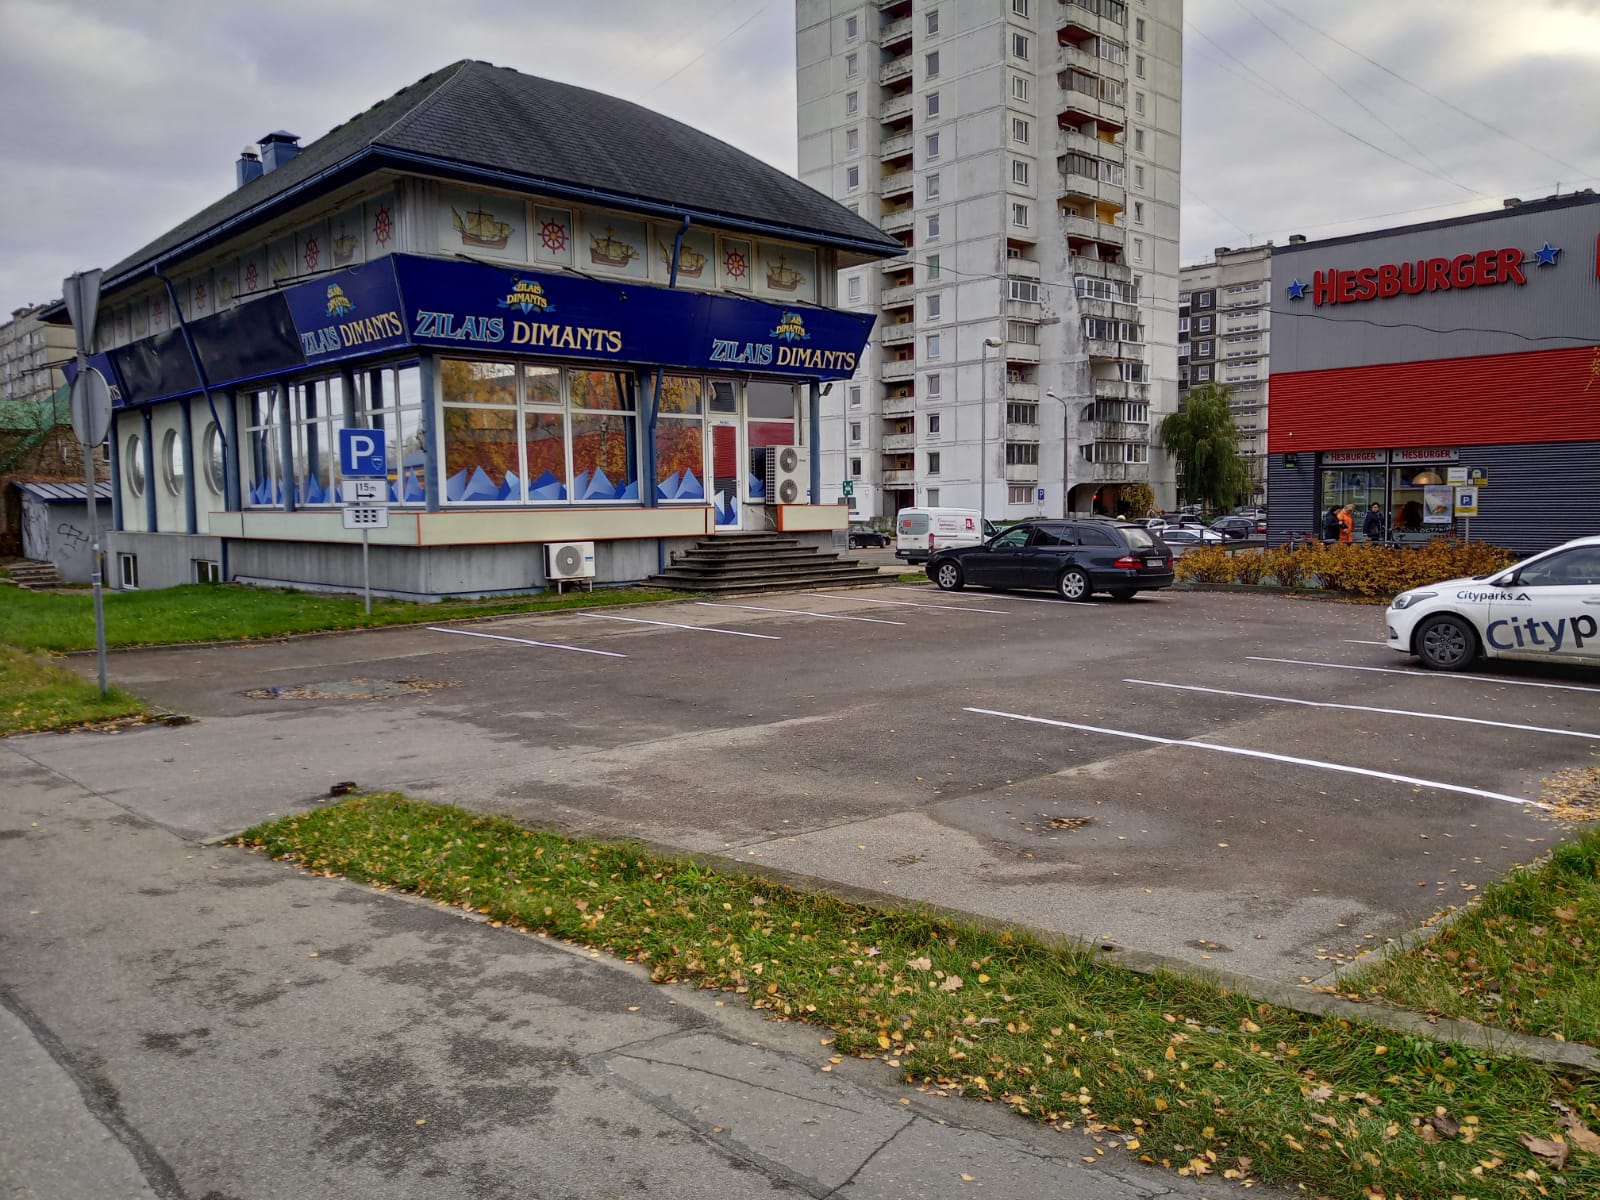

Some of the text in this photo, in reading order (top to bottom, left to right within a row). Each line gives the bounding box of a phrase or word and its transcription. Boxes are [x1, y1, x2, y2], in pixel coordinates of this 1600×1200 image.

[1312, 247, 1526, 307] HESBURGER
[506, 292, 547, 308] DIMANTS
[300, 311, 403, 356] ZILAIS DIMANTS
[413, 308, 622, 352] ZILAIS DIMANTS
[709, 338, 856, 371] ZILAIS DIMANTS
[350, 435, 375, 470] P
[1331, 452, 1377, 461] HESBURGER
[1402, 450, 1451, 460] HESBURGER
[1463, 496, 1470, 505] P
[1456, 590, 1513, 602] Cityparks
[1486, 614, 1598, 652] Cityp
